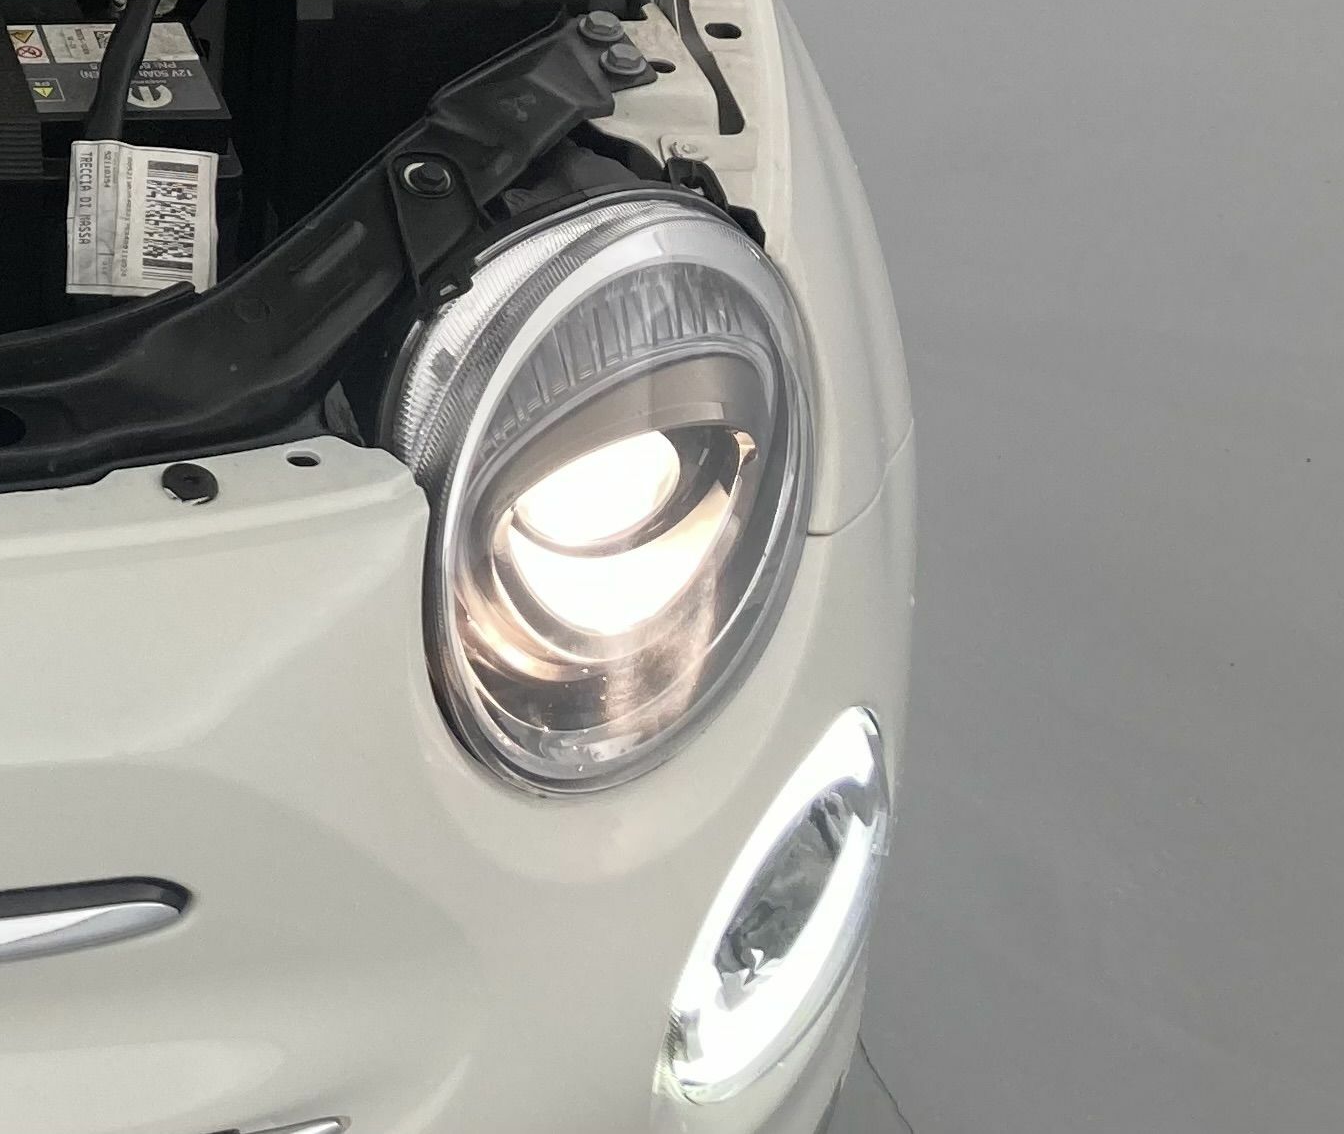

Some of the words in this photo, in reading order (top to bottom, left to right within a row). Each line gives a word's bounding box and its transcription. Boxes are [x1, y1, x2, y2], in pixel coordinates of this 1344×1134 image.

[79, 151, 93, 191] TRECCIA
[79, 197, 92, 208] DI
[78, 214, 92, 245] MASSA
